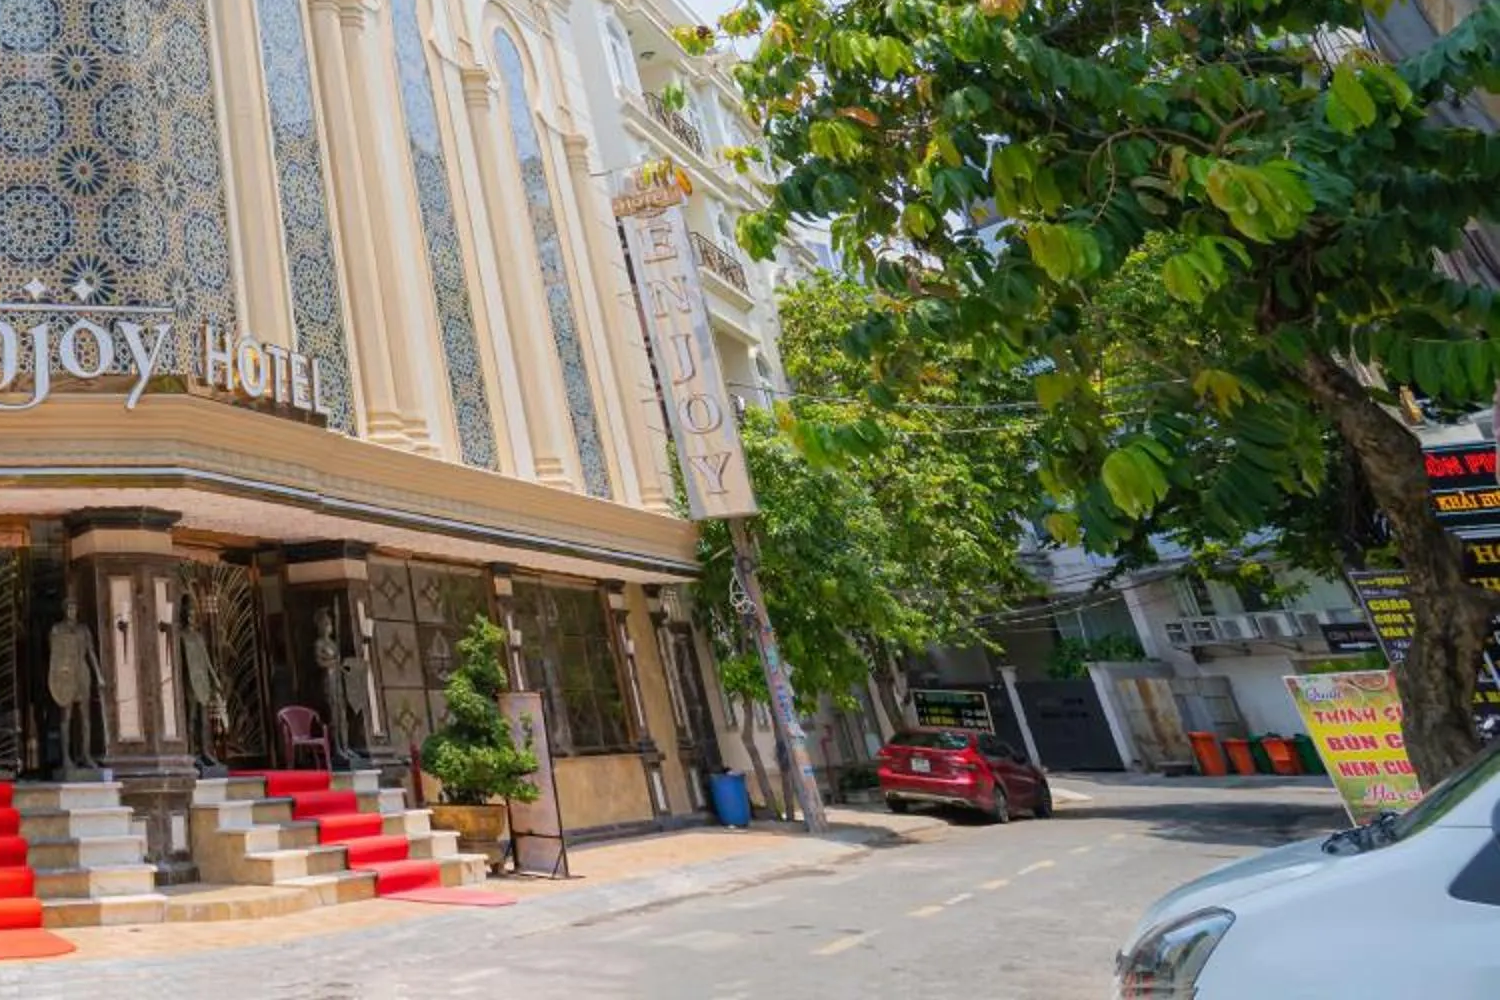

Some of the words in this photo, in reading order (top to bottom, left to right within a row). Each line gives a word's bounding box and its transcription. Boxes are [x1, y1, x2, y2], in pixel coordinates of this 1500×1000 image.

[204, 324, 330, 415] HOTEL
[638, 225, 732, 495] ENJOY
[1338, 760, 1380, 776] NEM
